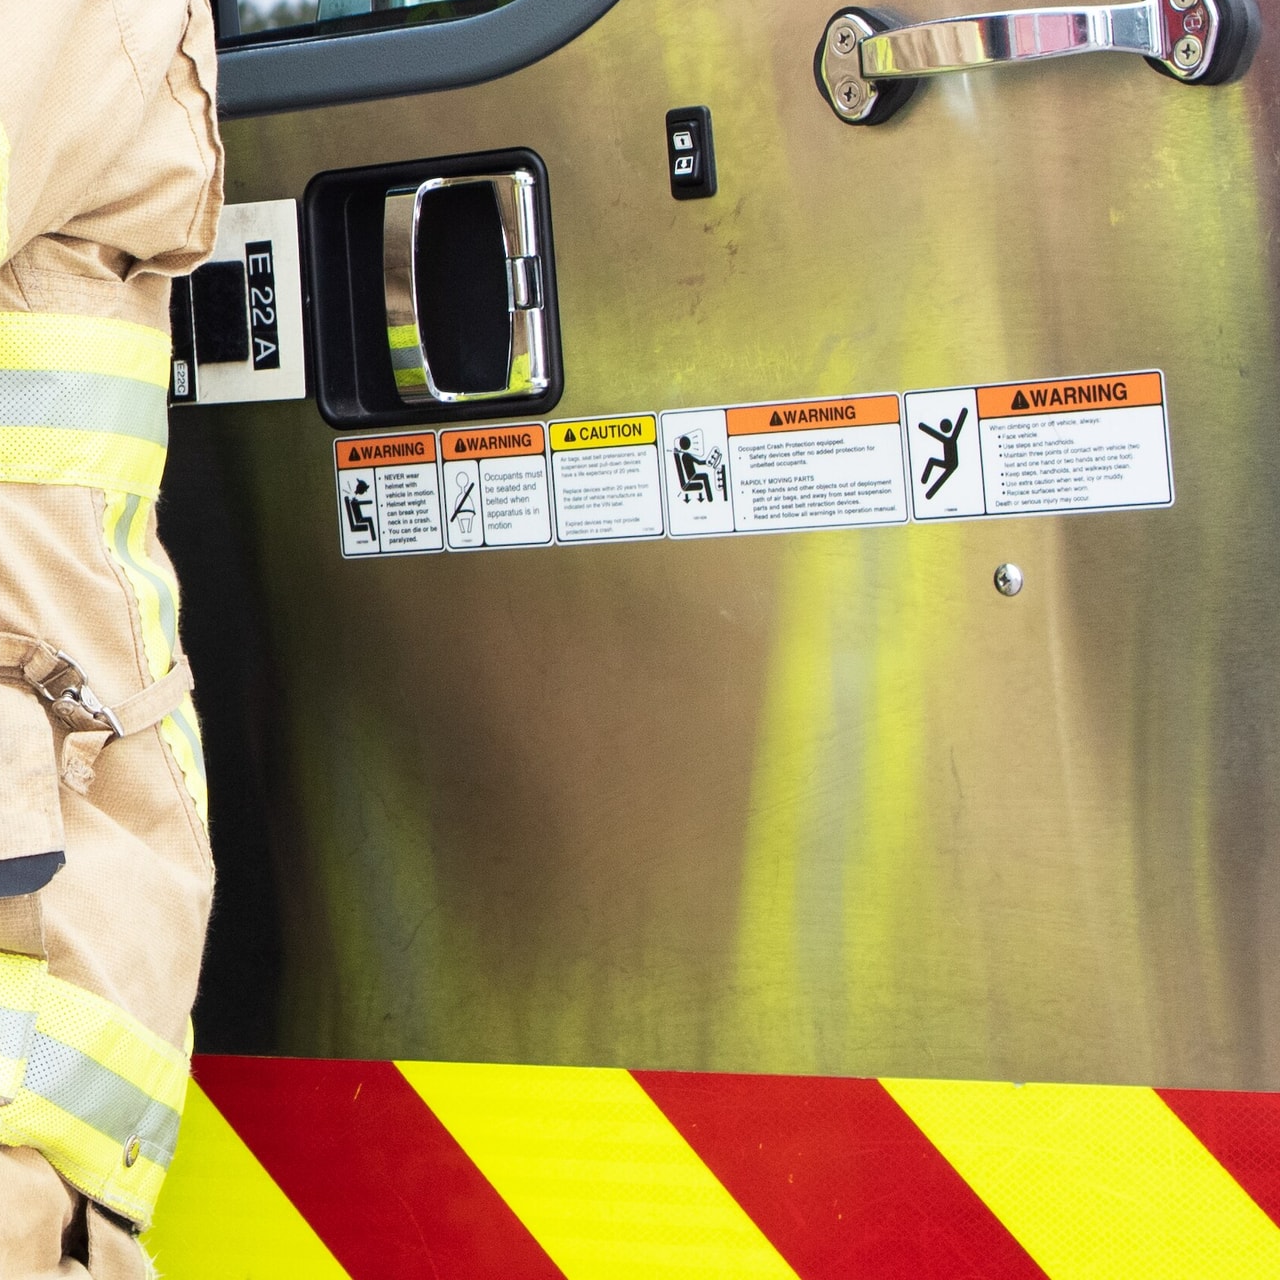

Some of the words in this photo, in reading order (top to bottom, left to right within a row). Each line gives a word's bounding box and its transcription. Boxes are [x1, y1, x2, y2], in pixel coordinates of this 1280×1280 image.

[249, 251, 271, 276] E
[251, 286, 275, 327] 22
[254, 336, 277, 363] A
[176, 362, 186, 395] E22C
[1030, 382, 1128, 408] WARNING
[784, 405, 856, 425] WARNING
[579, 423, 643, 441] CAUTION
[361, 442, 425, 460] WARNING
[466, 433, 532, 452] WARNING
[483, 470, 523, 483] Occupants
[524, 468, 543, 478] must
[484, 484, 494, 493] be
[496, 482, 520, 492] seated
[522, 481, 536, 491] and
[485, 495, 508, 505] belted
[509, 494, 529, 504] when
[486, 507, 523, 520] apparatus
[524, 506, 531, 515] is
[532, 506, 539, 514] in
[487, 520, 512, 530] motion
